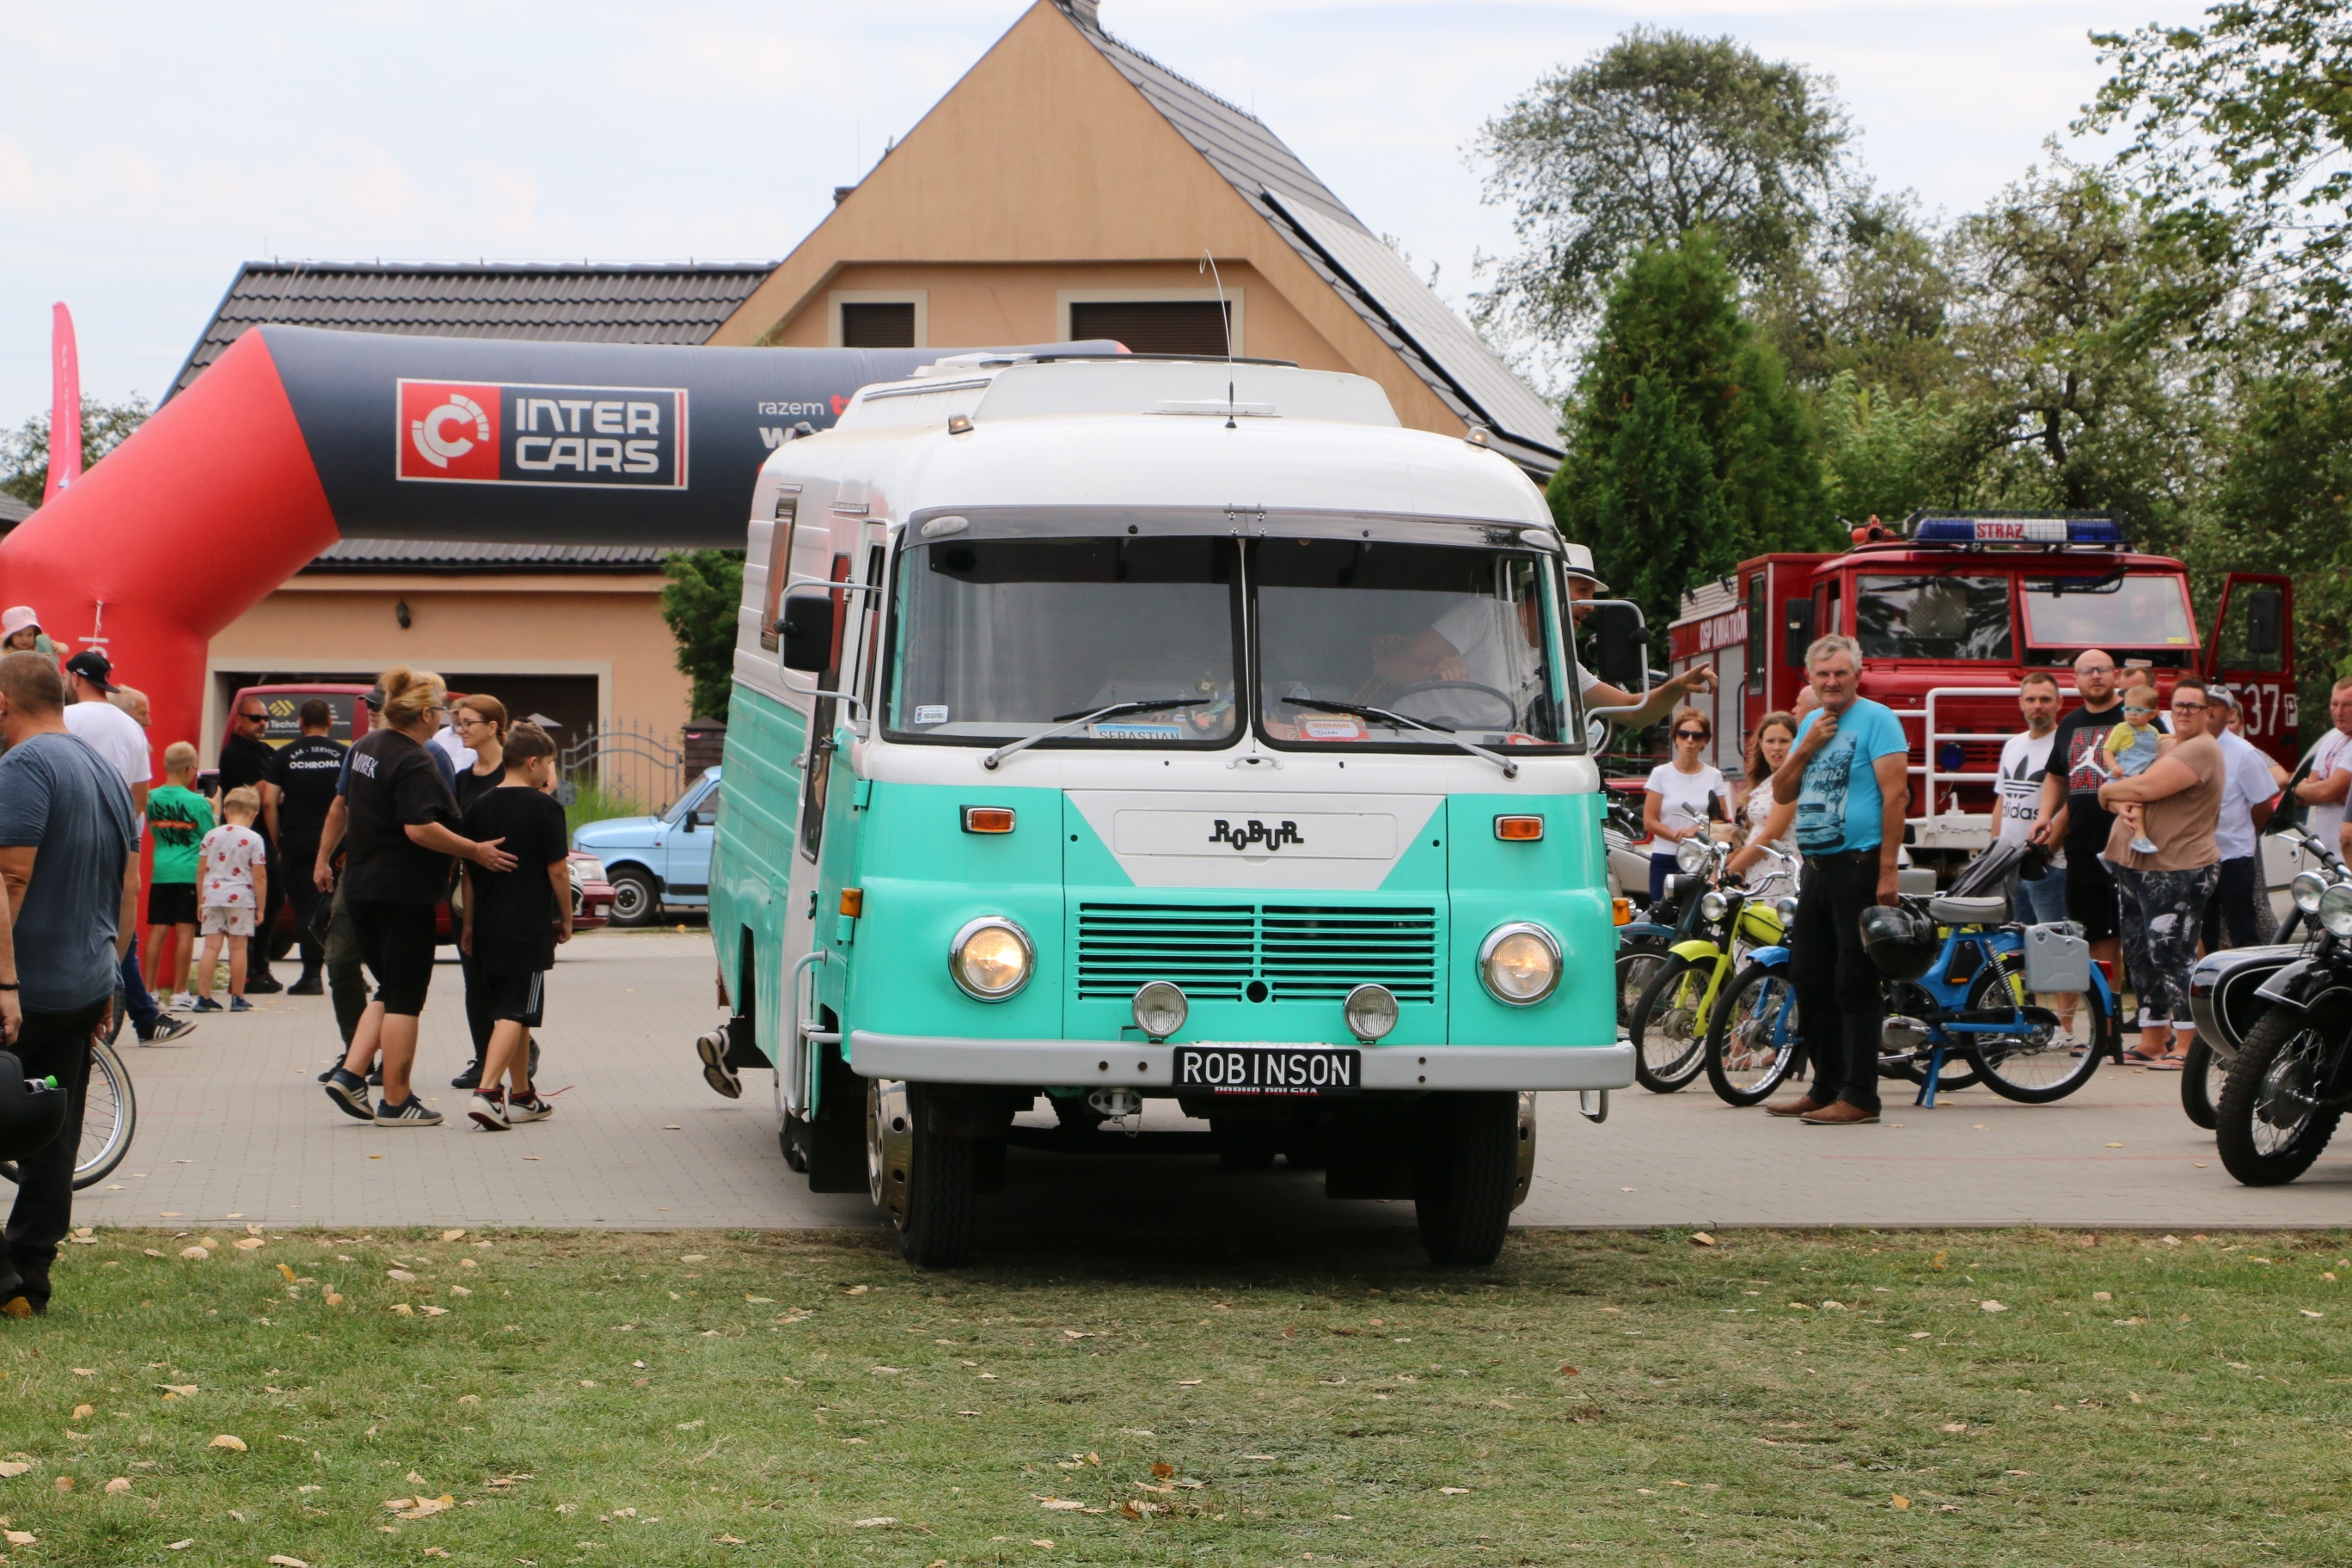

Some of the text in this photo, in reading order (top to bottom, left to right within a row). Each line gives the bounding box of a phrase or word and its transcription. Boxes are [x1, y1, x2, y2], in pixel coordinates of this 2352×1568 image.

[516, 398, 659, 435] INTER
[757, 401, 824, 415] razem
[515, 436, 659, 474] CARS
[1700, 619, 1712, 651] OSP
[270, 720, 300, 728] Techni
[289, 760, 341, 769] OCHRONA
[310, 746, 341, 758] SERVICE
[351, 750, 379, 779] MIREK
[1208, 819, 1304, 851] ROBUR
[1183, 1051, 1351, 1086] ROBINSON
[1214, 1086, 1320, 1097] ROBUR POLSKA
